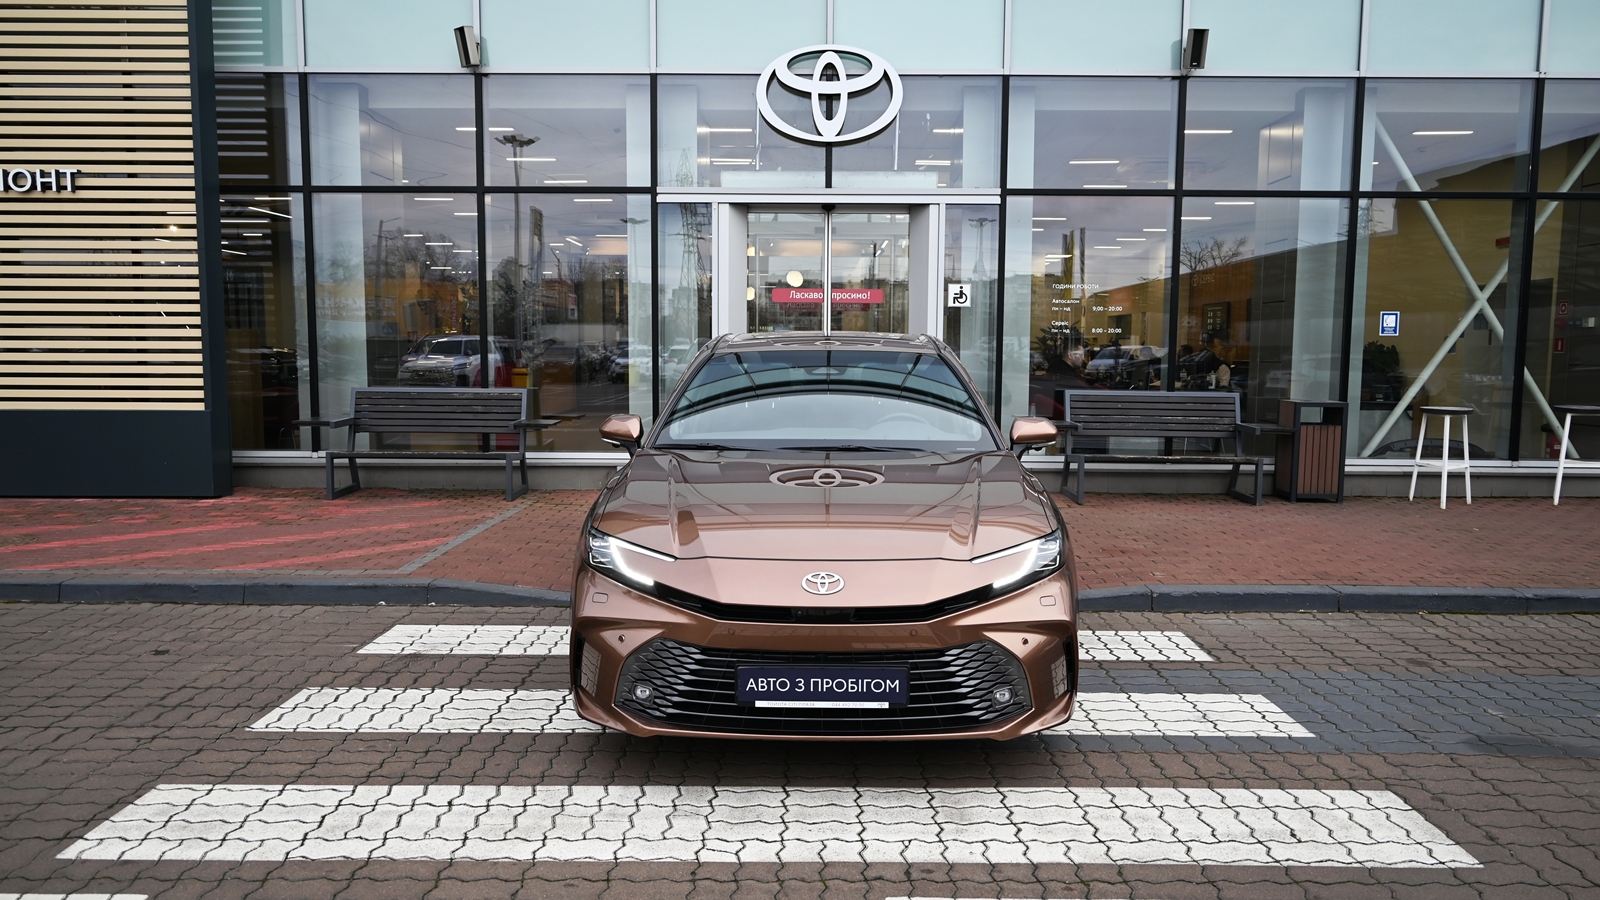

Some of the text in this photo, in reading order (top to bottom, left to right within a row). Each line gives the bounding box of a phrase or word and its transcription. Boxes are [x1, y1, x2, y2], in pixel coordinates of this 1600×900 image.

[0, 168, 78, 192] ОНТ
[790, 290, 870, 300] Ласкаво просимо!
[746, 678, 900, 692] АВТО З ПРОБІГОМ
